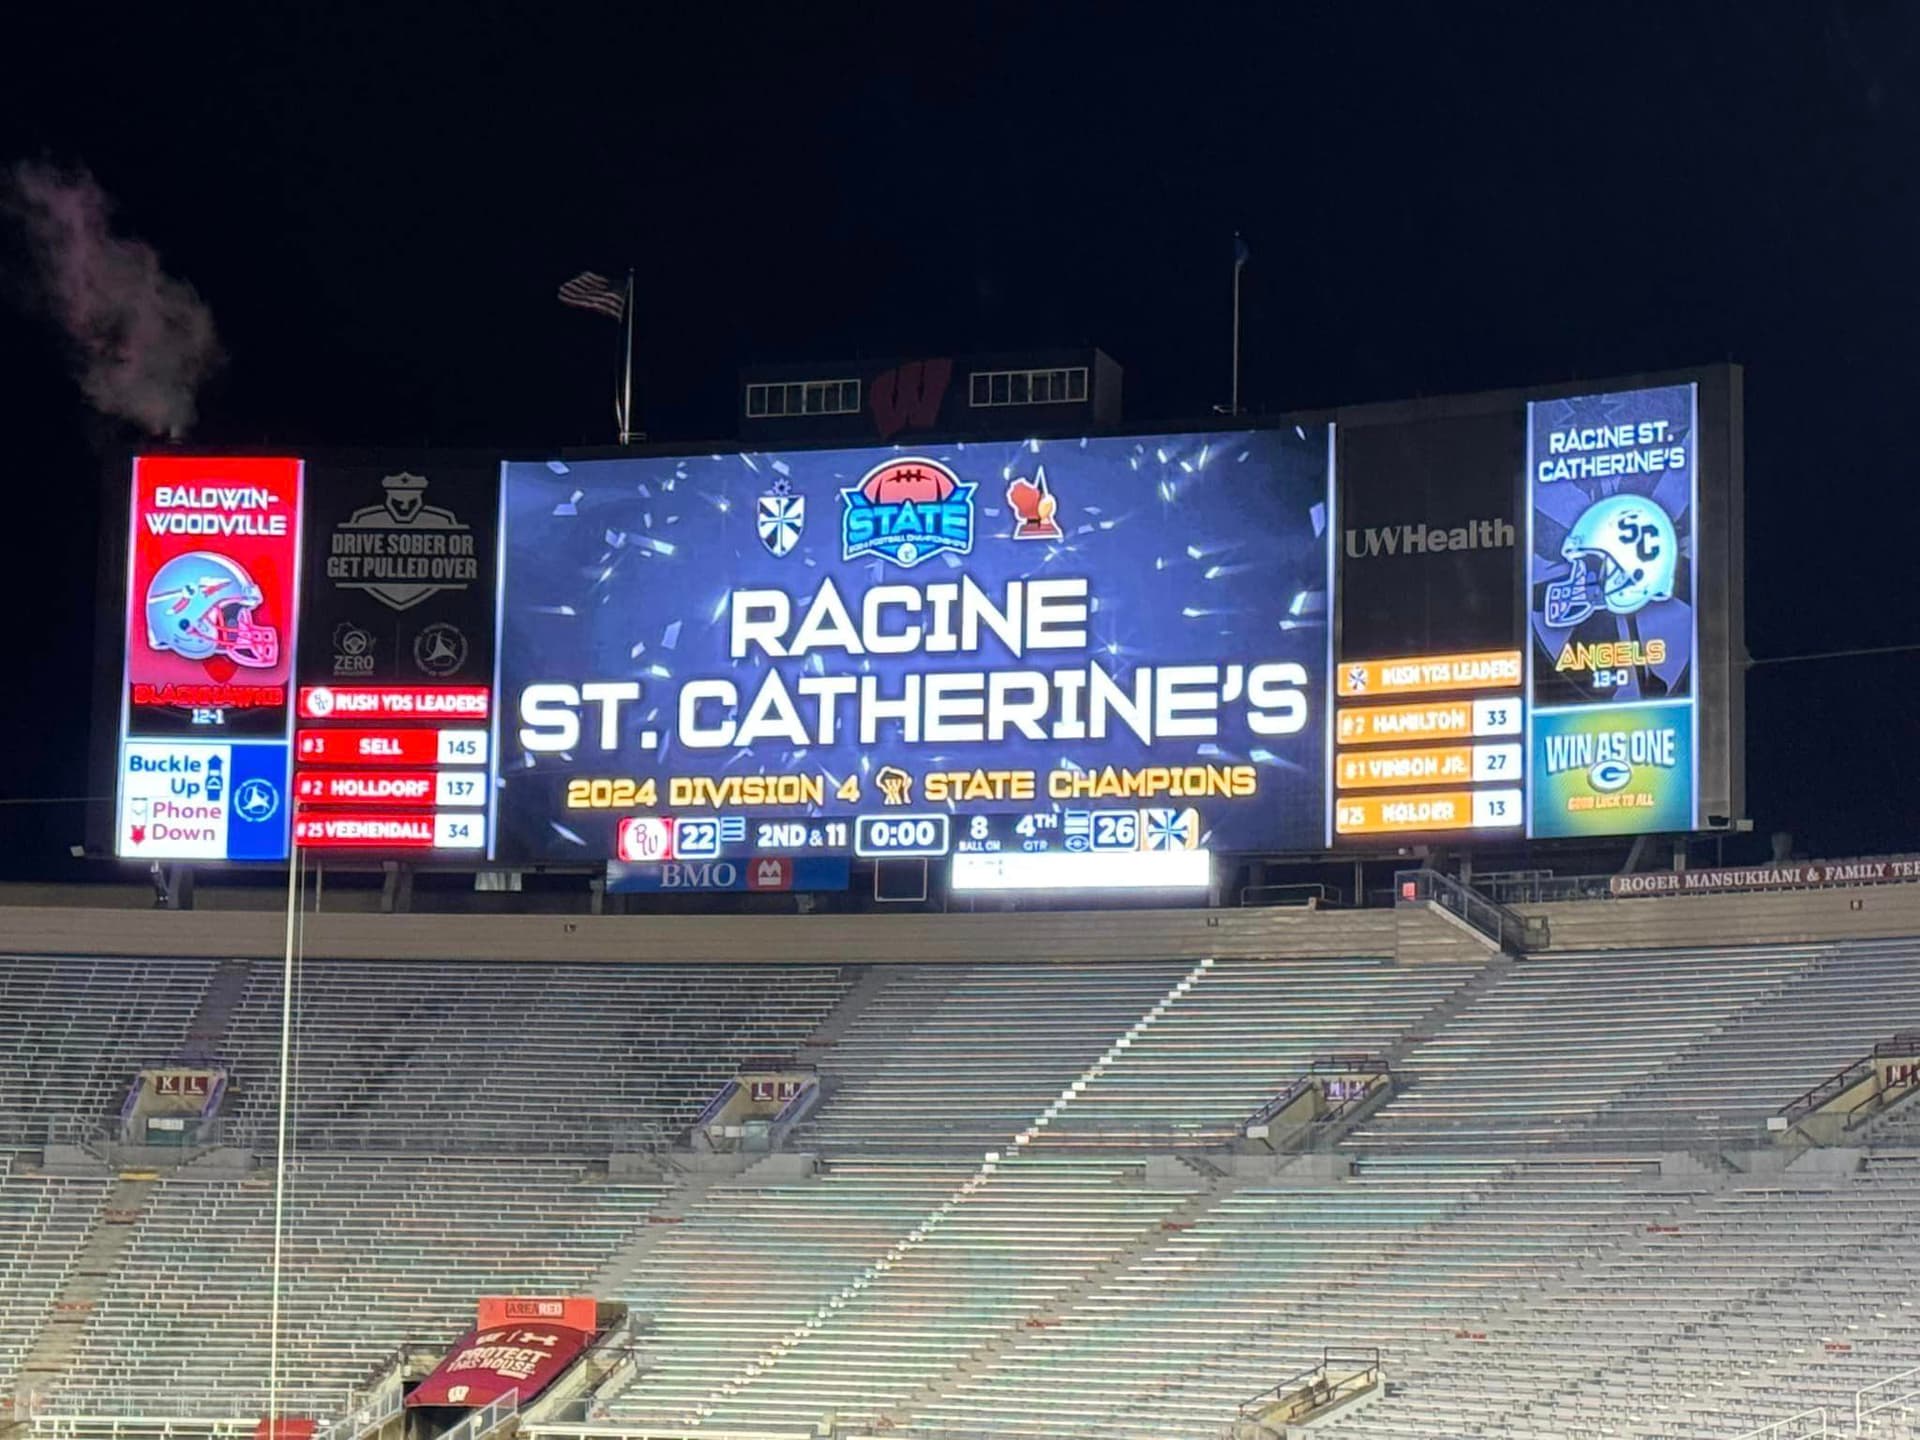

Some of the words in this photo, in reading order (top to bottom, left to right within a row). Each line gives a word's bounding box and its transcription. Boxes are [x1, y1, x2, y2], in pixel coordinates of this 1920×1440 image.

[1549, 427, 1637, 454] RACINE
[1638, 421, 1673, 444] ST.
[1538, 447, 1686, 482] CATHERINE'S
[154, 486, 279, 510] BALDWIN-
[145, 514, 287, 536] WOODVILLE
[849, 500, 967, 543] STATE
[332, 533, 385, 555] DRIVE
[387, 534, 446, 555] SOBER
[450, 534, 474, 555] OR
[327, 558, 361, 578] GET
[362, 558, 430, 578] PULLED
[431, 558, 478, 580] OVER
[731, 574, 1088, 659] RACINE
[334, 655, 374, 670] ZERO
[1555, 639, 1666, 673] ANGELS
[1381, 665, 1419, 686] RUSH
[1422, 663, 1450, 684] YDS
[1452, 659, 1517, 682] LEADERS
[1592, 671, 1628, 688] 13-0
[335, 694, 379, 711] RUSH
[381, 694, 413, 711] YDS
[415, 694, 487, 712] LEADERS
[519, 681, 658, 752] ST.
[678, 659, 1308, 750] CATHERINE'S
[192, 709, 225, 724] 12-1
[1373, 709, 1466, 734] HAMILTON
[1487, 710, 1507, 725] 33
[358, 738, 403, 755] SELL
[447, 740, 477, 755] 145
[1545, 732, 1593, 774] WIN
[1596, 731, 1627, 761] AS
[1631, 728, 1676, 767] ONE
[129, 755, 201, 772] Buckle
[1441, 756, 1468, 775] JR.
[1487, 755, 1507, 770] 27
[171, 778, 200, 797] Up
[330, 780, 430, 797] HOLLDORF
[447, 781, 475, 796] 137
[567, 778, 657, 809] 2024
[669, 775, 823, 808] DIVISION
[836, 775, 860, 803] 4
[924, 769, 1035, 800] STATE
[1049, 764, 1257, 798] CHAMPIONS
[152, 802, 222, 820] Phone
[1488, 801, 1506, 816] 13
[1595, 795, 1621, 809] LUCK
[1621, 795, 1635, 808] TO
[1635, 793, 1654, 807] ALL
[152, 824, 216, 841] Down
[448, 824, 469, 838] 34
[757, 824, 806, 848] 2ND
[808, 830, 823, 847] &
[825, 823, 846, 847] 11
[870, 821, 935, 847] 0:00
[970, 816, 989, 839] 8
[1015, 813, 1058, 837] 4TH
[1097, 818, 1136, 844] 26
[681, 825, 714, 850] 22
[959, 841, 985, 851] BALL
[985, 841, 1001, 851] ON
[1023, 841, 1048, 851] QTR
[660, 863, 737, 888] BMO
[1618, 874, 1681, 892] ROGER
[1685, 868, 1801, 889] MANSUKHANI
[1806, 867, 1820, 882] &
[1824, 863, 1887, 881] FAMILY
[162, 1077, 173, 1090] K
[191, 1077, 201, 1090] L
[758, 1082, 768, 1096] L
[784, 1082, 794, 1096] M
[457, 1346, 552, 1363] PROTECT
[446, 1359, 477, 1373] THIS
